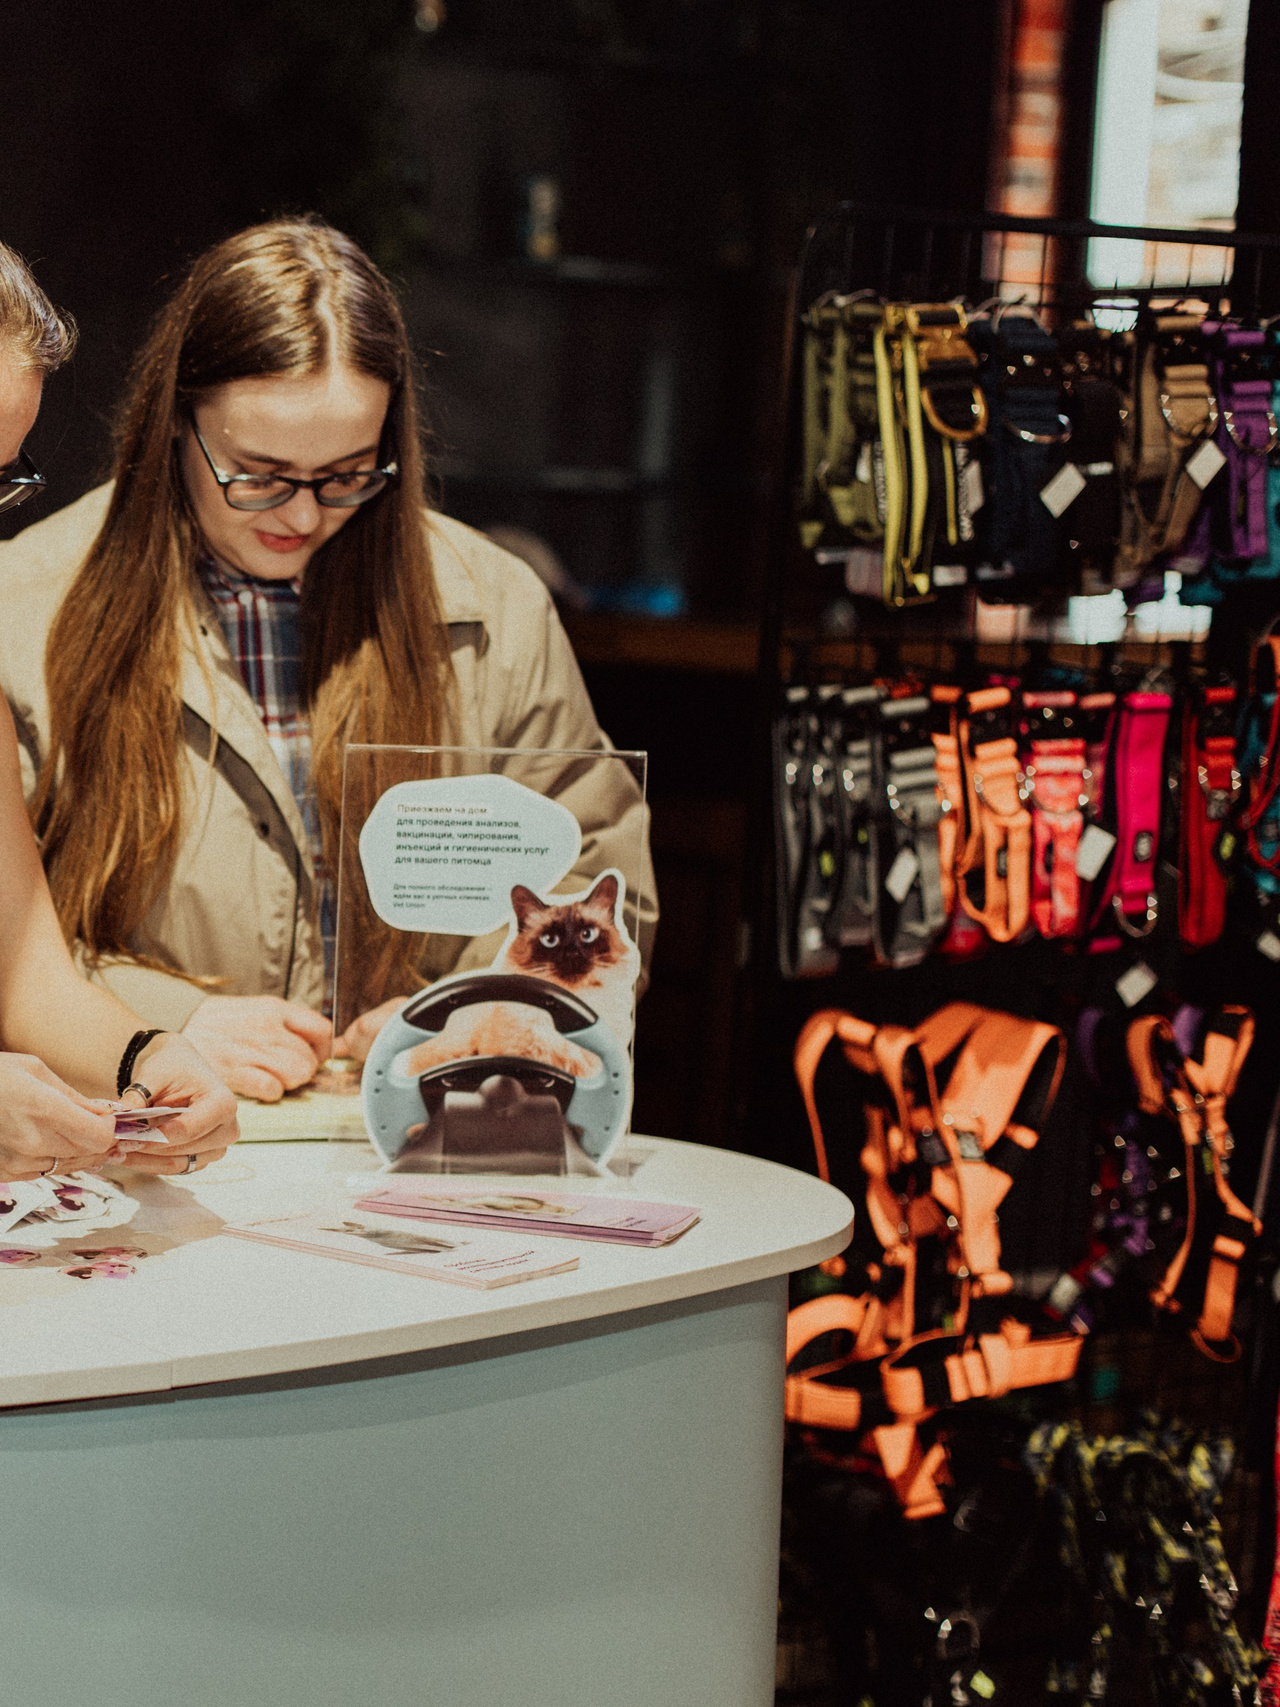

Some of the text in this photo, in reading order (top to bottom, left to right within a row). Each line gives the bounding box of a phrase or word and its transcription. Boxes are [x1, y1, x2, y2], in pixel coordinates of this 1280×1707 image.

[397, 804, 452, 813] Приезжаем
[416, 819, 473, 827] проведения
[475, 820, 521, 828] анализов,
[457, 833, 521, 841] чипирования,
[396, 843, 442, 852] инъекций
[452, 844, 521, 853] гигиенических
[524, 847, 550, 856] услуг
[451, 857, 492, 866] питомца
